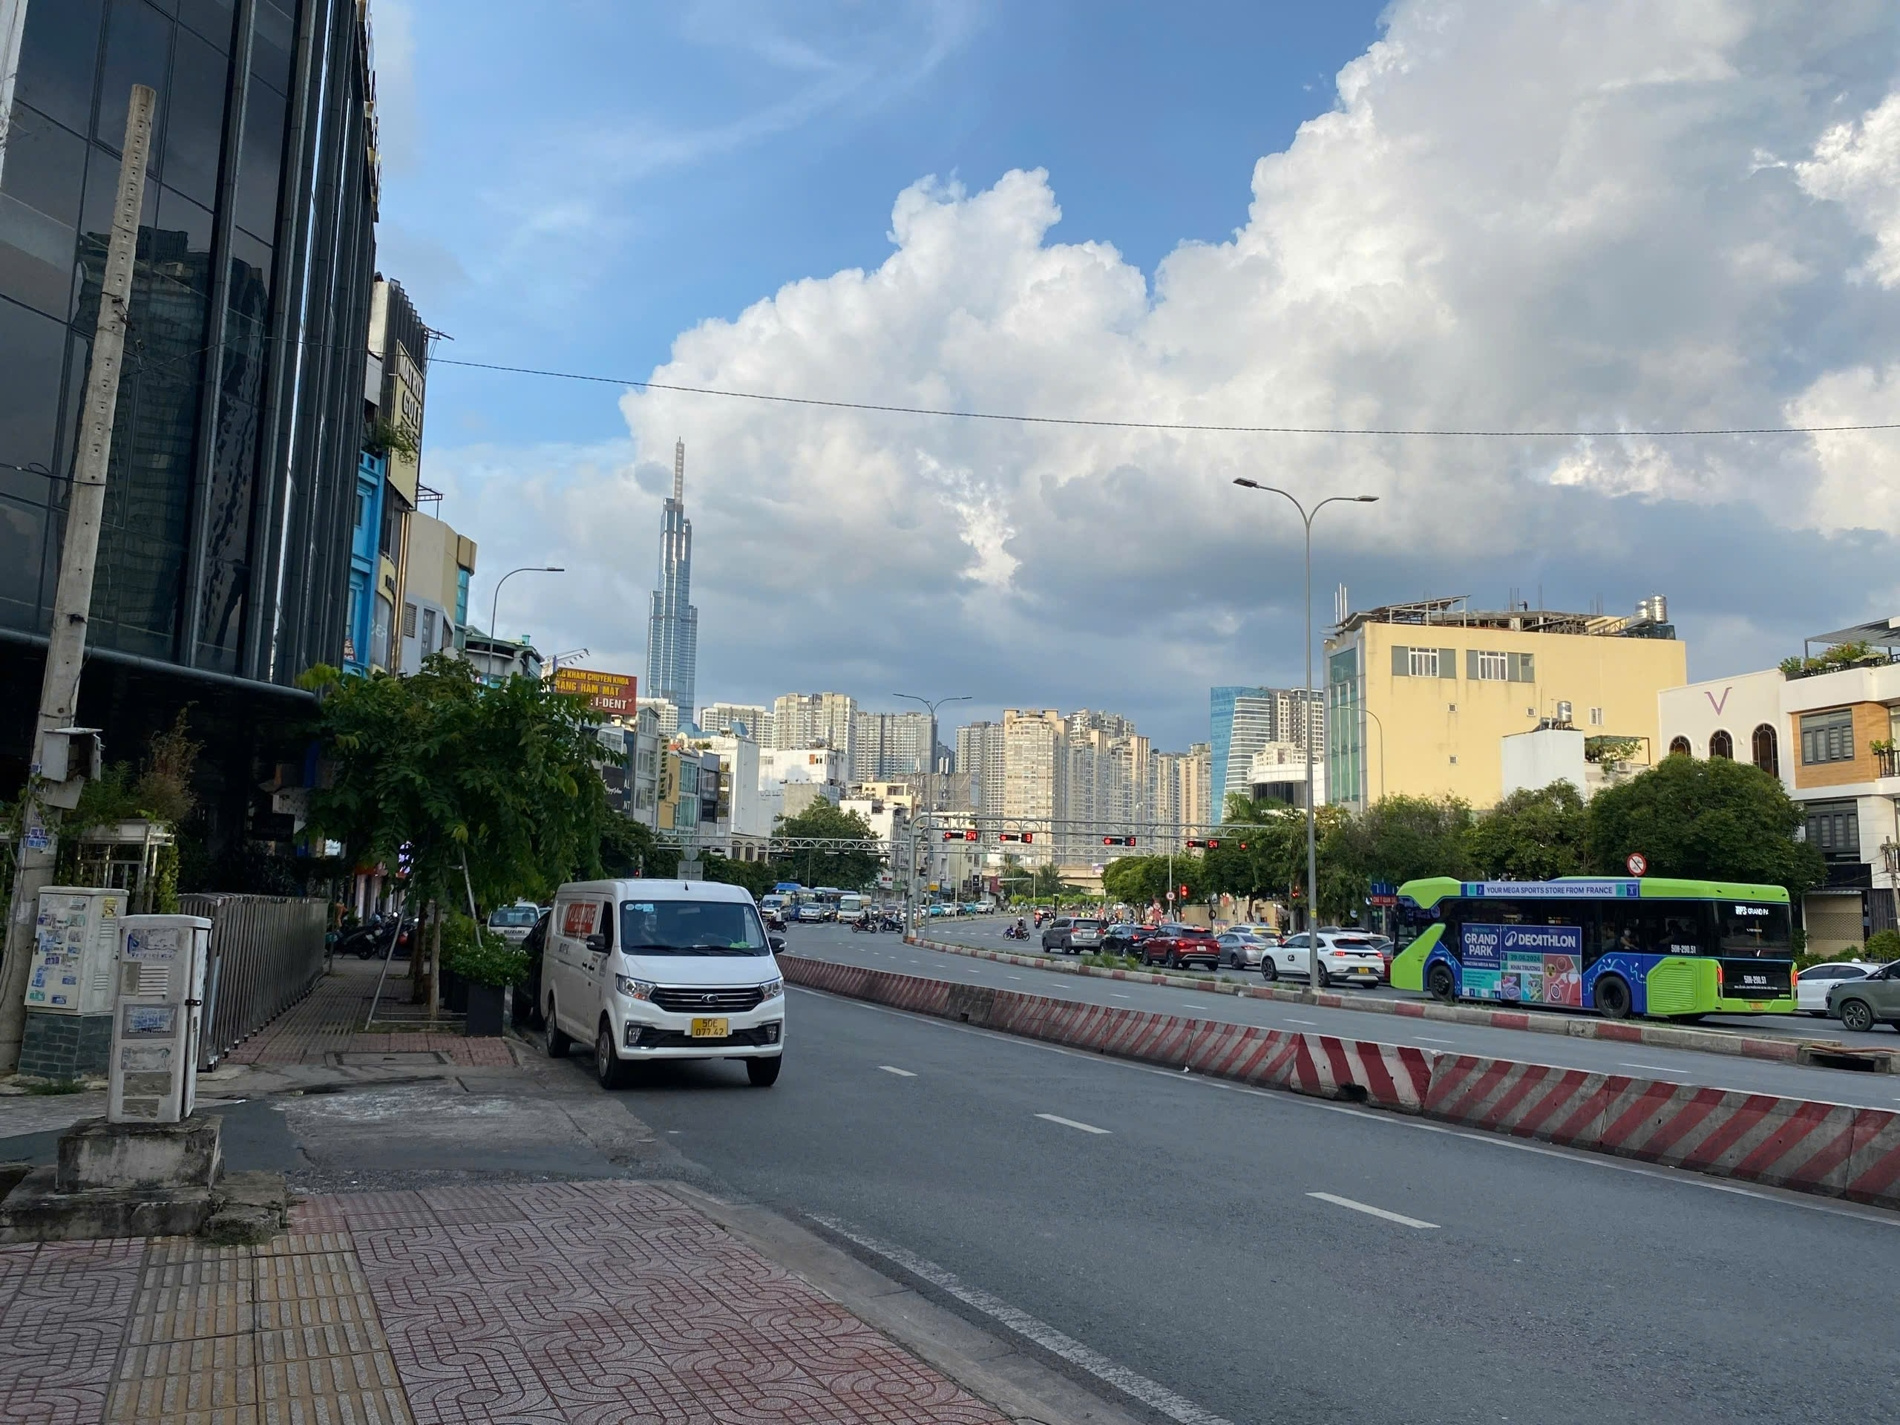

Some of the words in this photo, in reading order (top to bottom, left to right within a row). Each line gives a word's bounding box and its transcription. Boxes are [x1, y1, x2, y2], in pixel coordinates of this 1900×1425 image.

[967, 832, 977, 840] 54
[1486, 886, 1503, 894] YOUR
[1503, 886, 1521, 894] MEGA
[1521, 886, 1545, 894] SPORTS
[1545, 886, 1565, 894] STORE
[1566, 886, 1584, 894] FROM
[1586, 886, 1612, 894] FRANCE
[1464, 932, 1498, 945] GRAND
[1518, 935, 1576, 948] DECATHLON
[1469, 944, 1493, 957] PARK
[695, 1028, 724, 1036] 077.42
